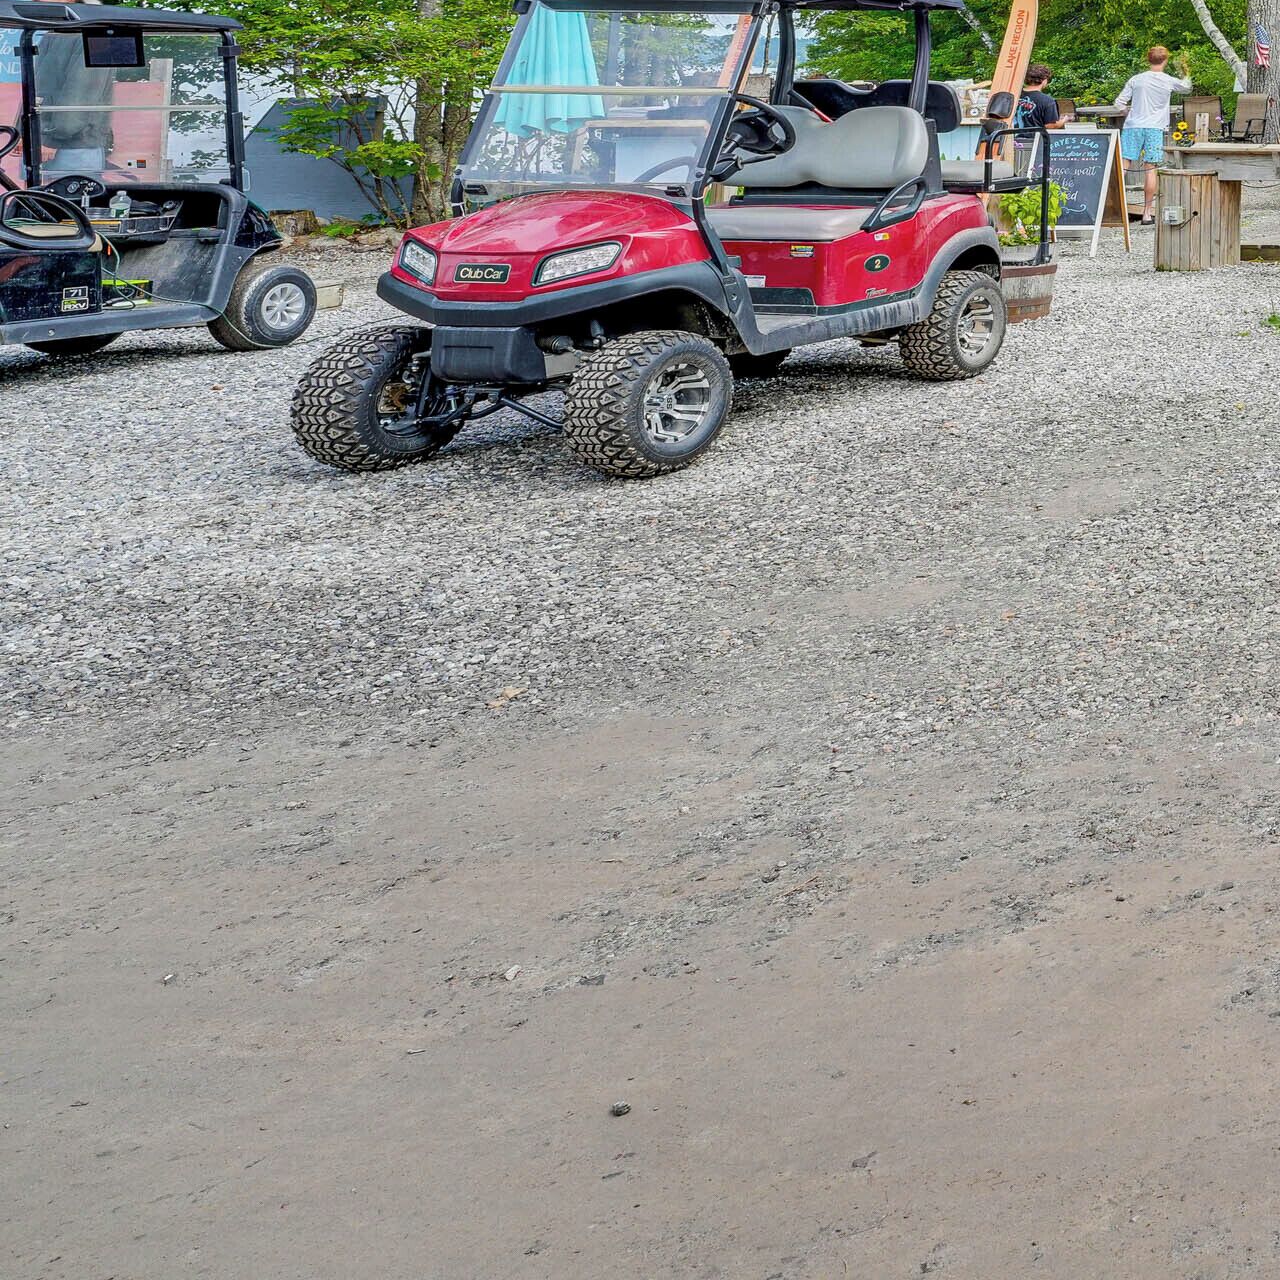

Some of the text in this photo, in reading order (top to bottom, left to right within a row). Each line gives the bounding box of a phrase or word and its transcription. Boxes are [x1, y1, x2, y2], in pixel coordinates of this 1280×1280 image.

[1005, 9, 1026, 69] LAKE REGION
[1080, 137, 1099, 149] LEAP
[1074, 165, 1101, 177] wait
[874, 258, 881, 269] 2
[460, 267, 504, 279] Club Car
[69, 289, 82, 297] 71
[63, 302, 86, 310] RXV
